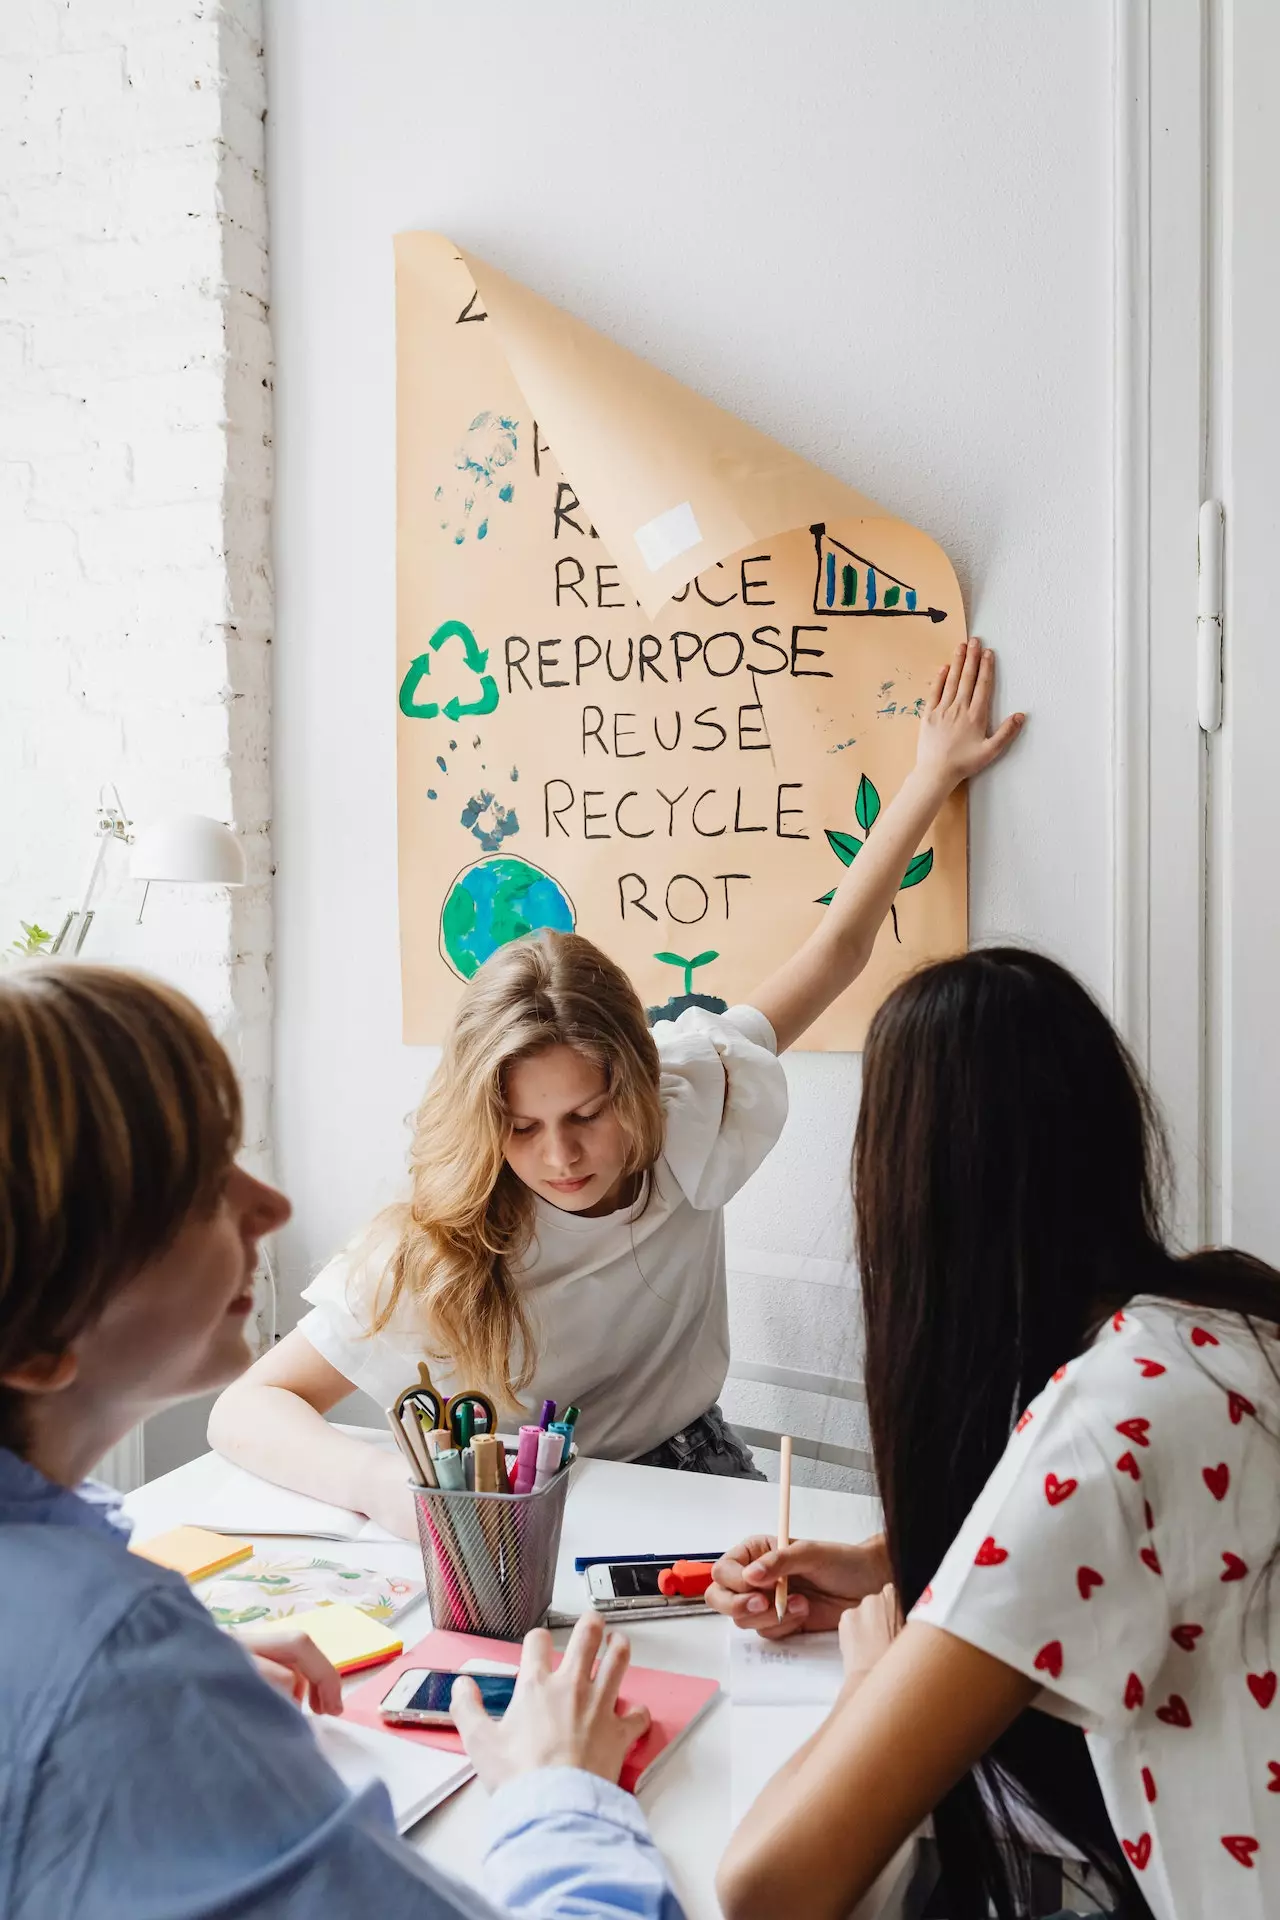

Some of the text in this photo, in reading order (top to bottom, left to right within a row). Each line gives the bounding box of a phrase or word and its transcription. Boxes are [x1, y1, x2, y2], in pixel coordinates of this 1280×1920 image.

[504, 625, 834, 694] REPURPOSE
[582, 704, 772, 758] REUSE
[544, 779, 811, 840] RECYCLE
[618, 872, 752, 925] ROT
